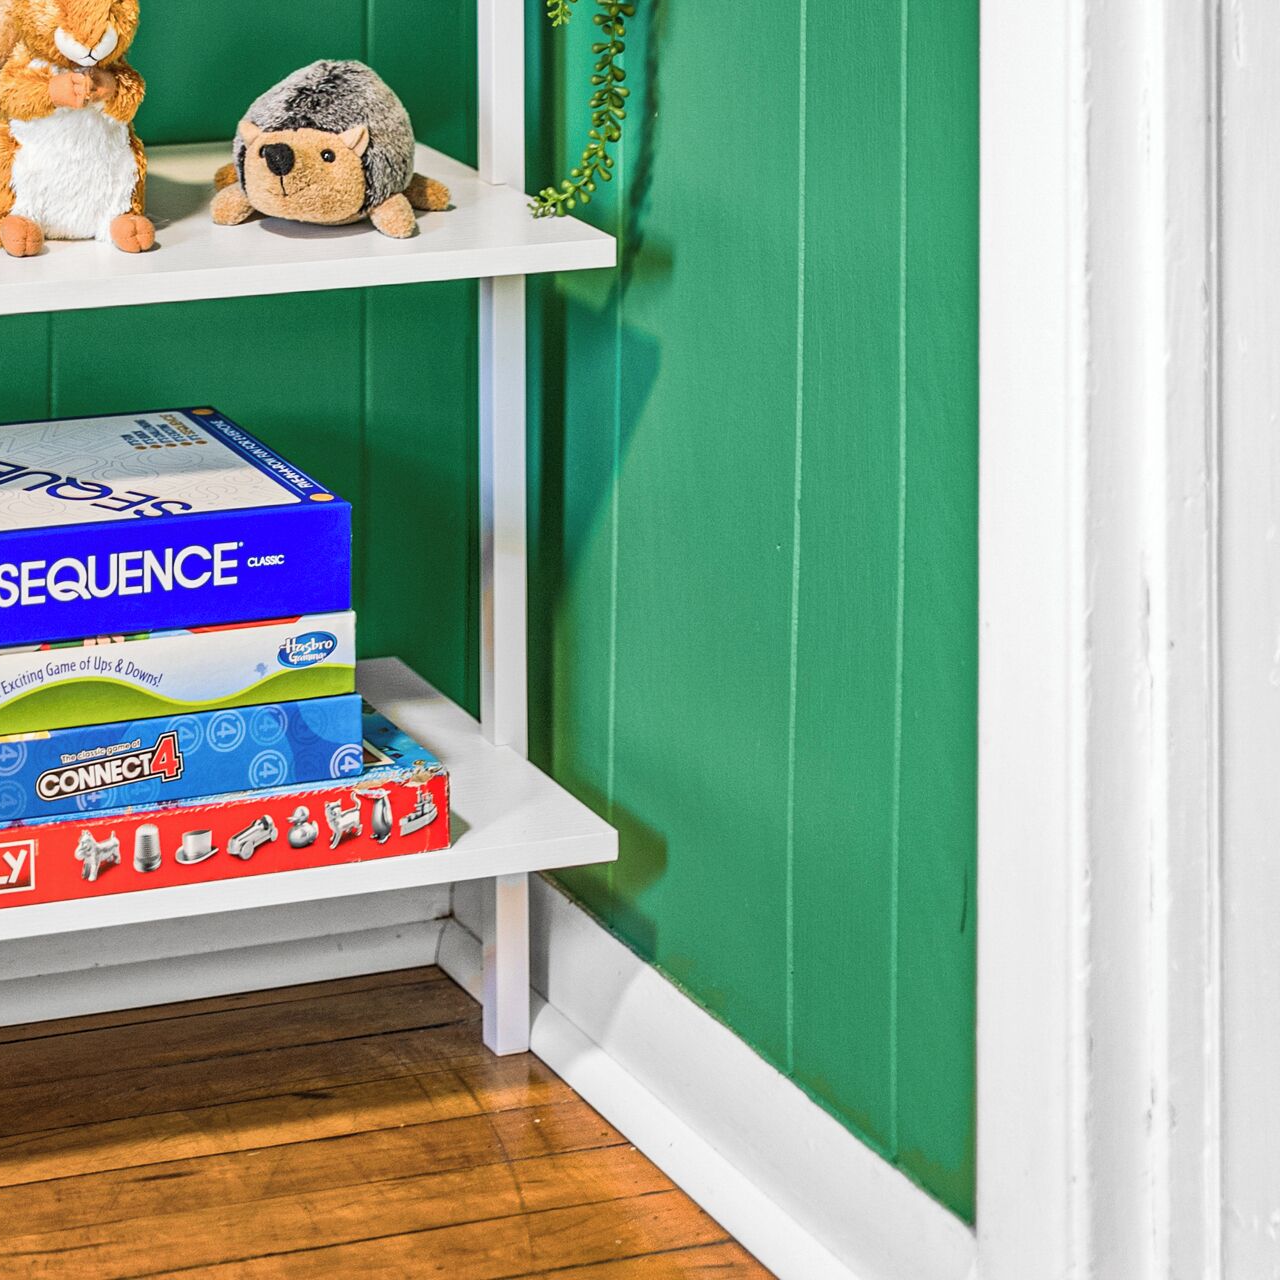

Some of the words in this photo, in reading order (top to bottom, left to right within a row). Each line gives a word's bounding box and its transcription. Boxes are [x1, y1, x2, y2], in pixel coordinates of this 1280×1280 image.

[247, 554, 285, 568] CLASSIC
[279, 636, 334, 654] Hasbro
[0, 670, 44, 695] Exciting
[46, 662, 77, 679] Game
[79, 659, 91, 672] of
[94, 658, 112, 675] Ups
[114, 660, 123, 672] &
[126, 663, 164, 687] Downs!
[61, 754, 76, 764] The
[77, 747, 106, 760] classic
[106, 743, 130, 756] game
[130, 738, 141, 748] of
